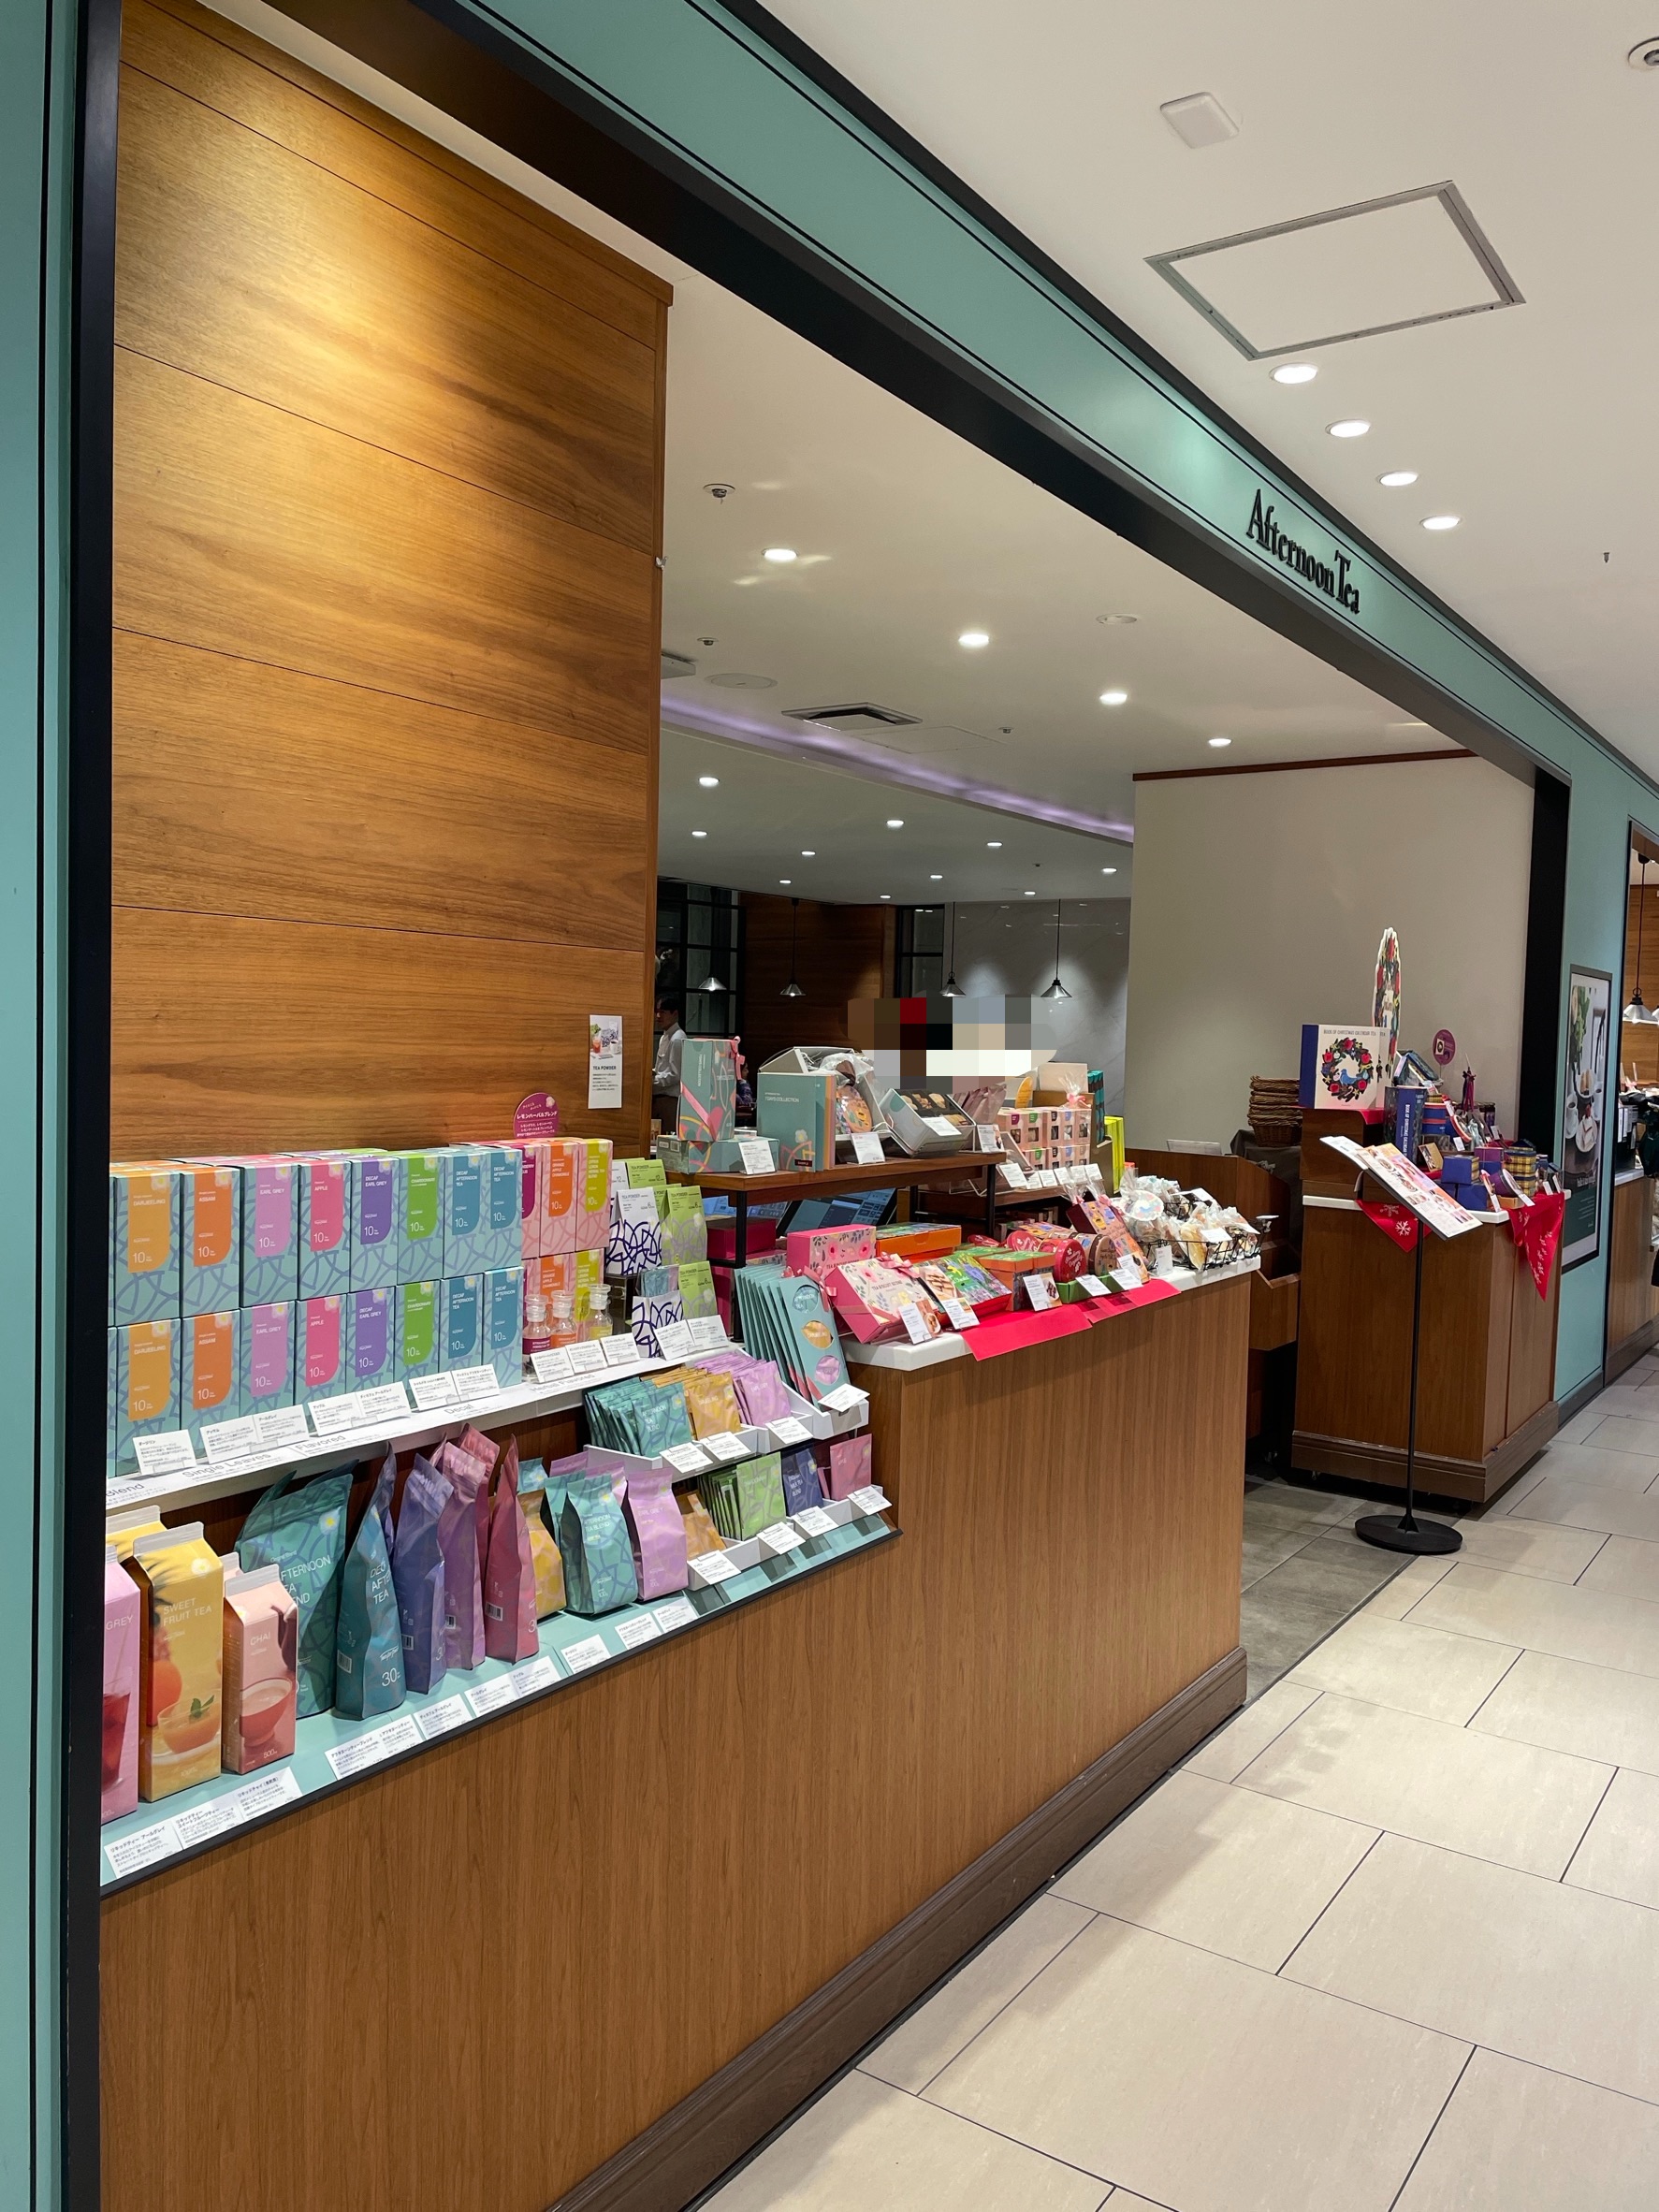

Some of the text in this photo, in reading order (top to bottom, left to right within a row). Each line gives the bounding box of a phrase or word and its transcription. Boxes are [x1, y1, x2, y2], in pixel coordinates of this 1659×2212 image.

[1245, 488, 1361, 615] Afternoon Tea
[551, 1201, 560, 1210] 10
[455, 1217, 464, 1228] 10
[493, 1212, 502, 1222] 10
[364, 1225, 374, 1236] 10
[410, 1221, 420, 1232] 10
[258, 1236, 270, 1248] 10
[313, 1231, 325, 1244] 10
[133, 1251, 146, 1263] 10
[197, 1245, 210, 1258] 10
[494, 1332, 502, 1342] 10
[134, 1345, 167, 1355] DARJEELING
[451, 1340, 460, 1350] 10
[406, 1346, 415, 1357] 10
[358, 1357, 369, 1368] 10
[310, 1366, 320, 1378] 10
[255, 1375, 267, 1388] 10
[197, 1388, 210, 1400] 10
[133, 1399, 146, 1411] 10
[295, 1434, 346, 1450] Flavored
[182, 1453, 271, 1477] Single Leaves
[281, 1555, 331, 1581] FTERNOON
[284, 1582, 297, 1594] EA
[373, 1590, 389, 1605] TEA
[163, 1597, 196, 1615] SWEET
[163, 1605, 212, 1626] FRUIT TEA
[106, 1615, 134, 1630] GREY
[250, 1631, 270, 1646] CHAI
[381, 1667, 398, 1687] 30
